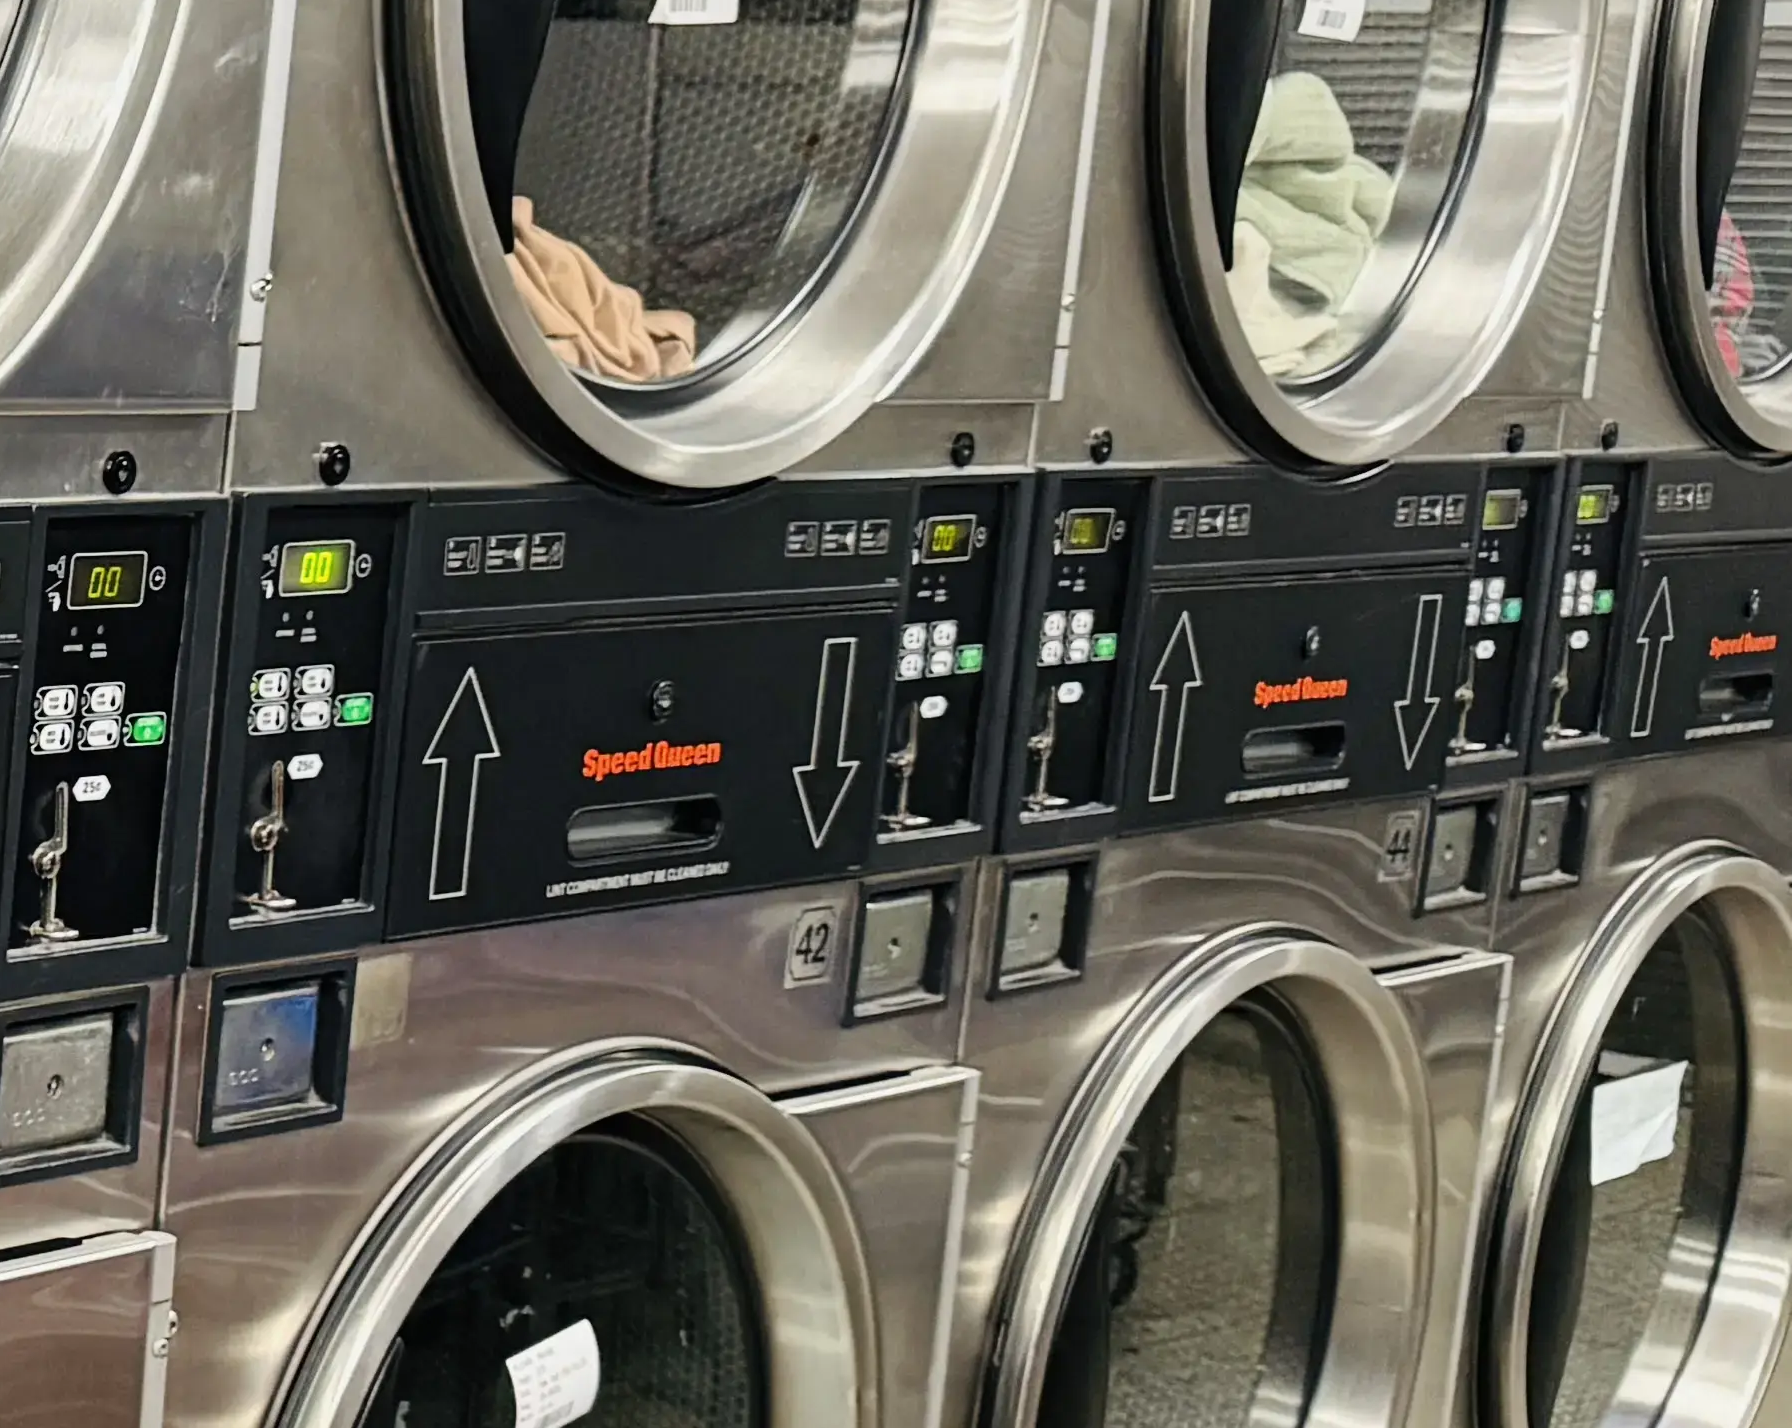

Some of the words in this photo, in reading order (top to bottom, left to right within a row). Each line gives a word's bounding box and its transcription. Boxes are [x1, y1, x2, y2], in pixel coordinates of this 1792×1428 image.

[88, 566, 122, 598] 00
[300, 551, 332, 584] 00
[1254, 678, 1301, 709] Speed
[582, 742, 654, 782] Speed
[654, 740, 721, 769] Queen
[1387, 829, 1410, 863] 44
[795, 923, 829, 964] 42
